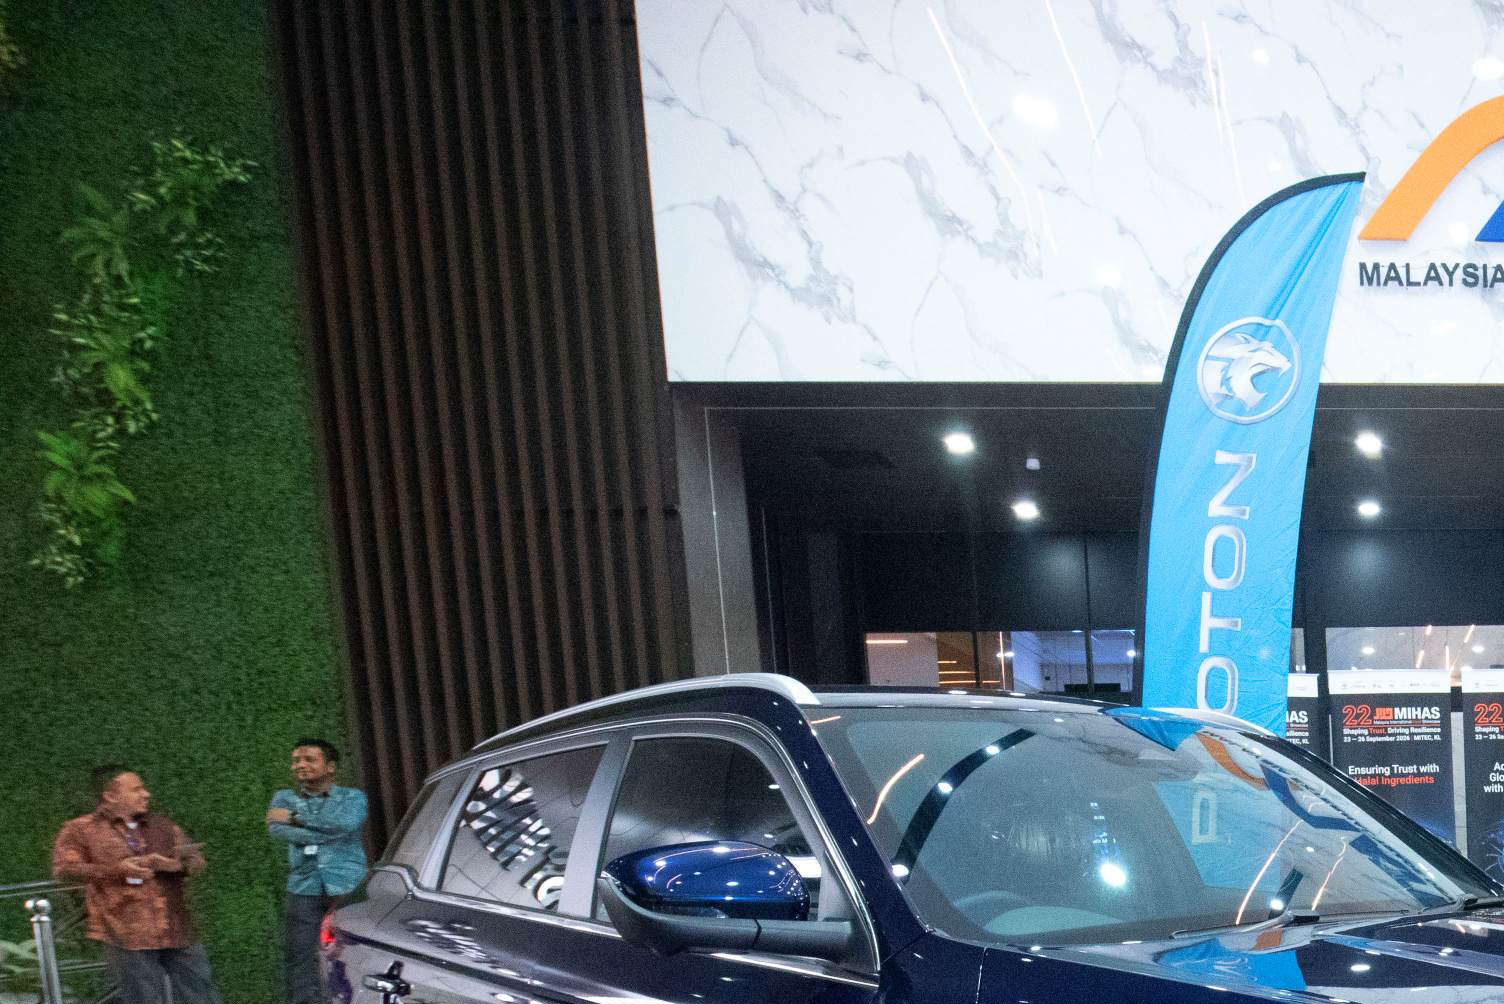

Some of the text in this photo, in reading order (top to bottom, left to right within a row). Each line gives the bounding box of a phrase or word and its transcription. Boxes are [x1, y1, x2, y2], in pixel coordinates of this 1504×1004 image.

[1197, 450, 1257, 716] OTON
[1342, 704, 1372, 725] 22
[1394, 706, 1441, 720] MIHAS
[1474, 703, 1503, 723] 22
[1388, 727, 1409, 735] Driving
[1348, 763, 1440, 777] Ensuring Trust with
[1381, 776, 1435, 787] Ingredients
[1483, 784, 1503, 793] with
